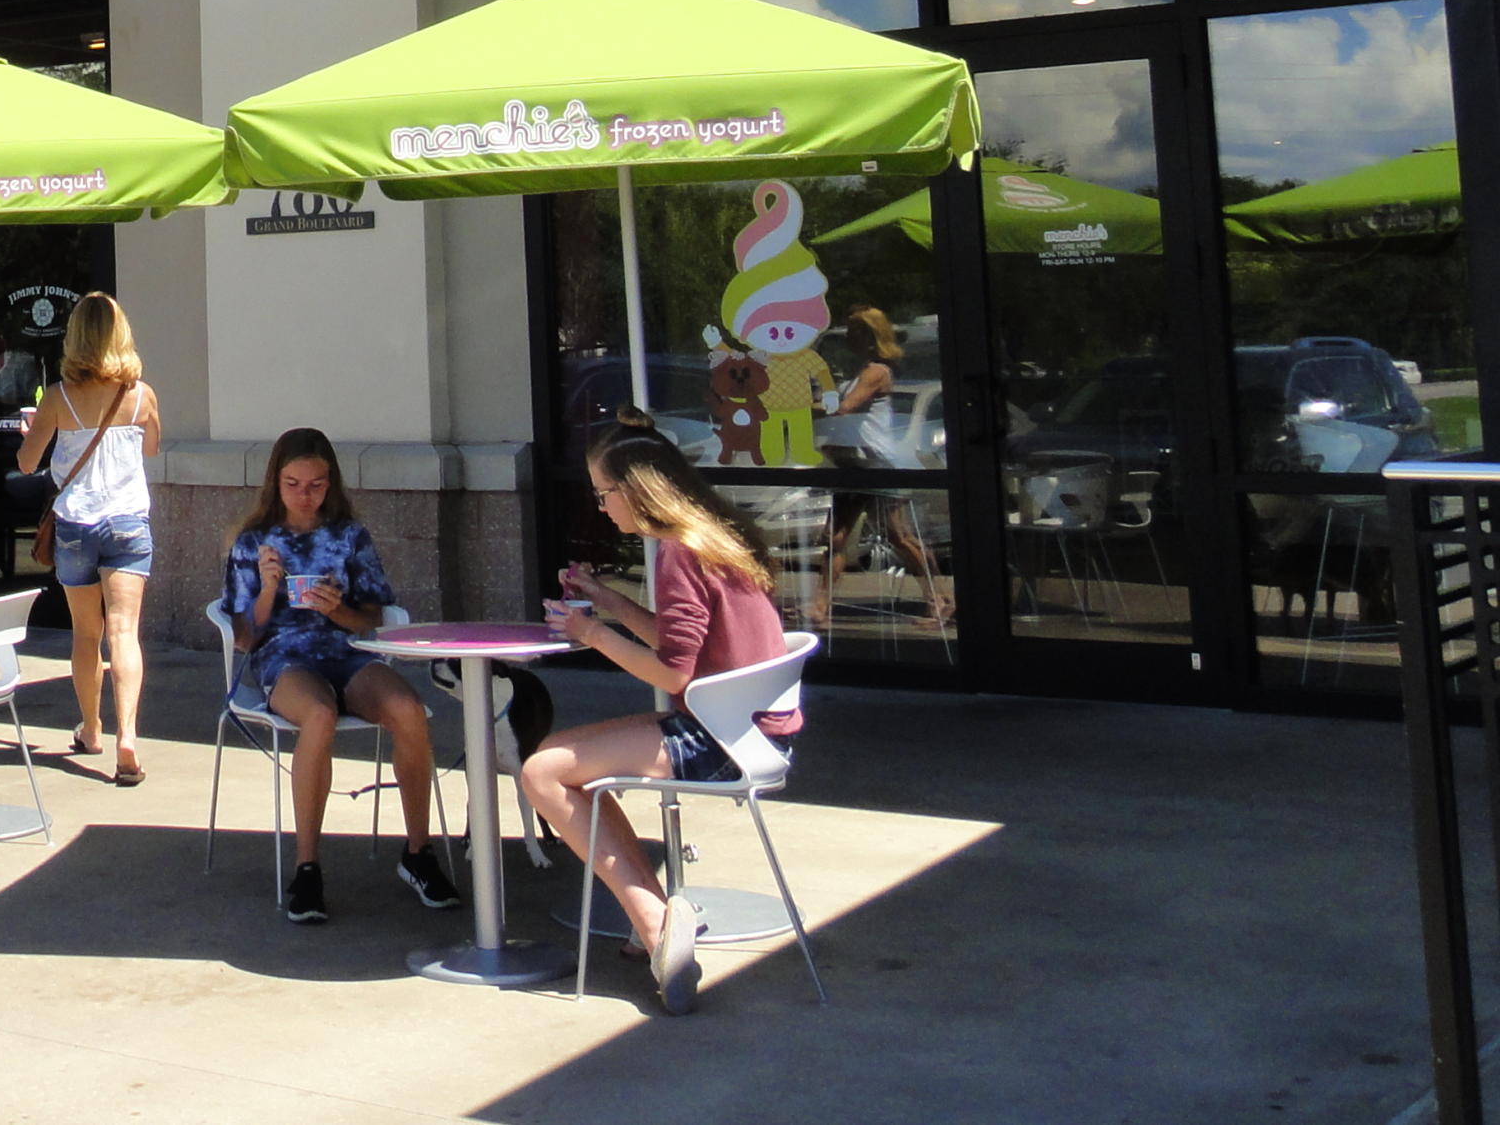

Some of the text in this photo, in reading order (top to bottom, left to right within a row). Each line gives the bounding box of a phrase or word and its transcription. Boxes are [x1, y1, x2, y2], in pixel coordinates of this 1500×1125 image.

[391, 99, 782, 160] menchie's frozen yogurt
[39, 169, 106, 196] yogurt
[8, 286, 81, 306] JIMMY JOHN'S
